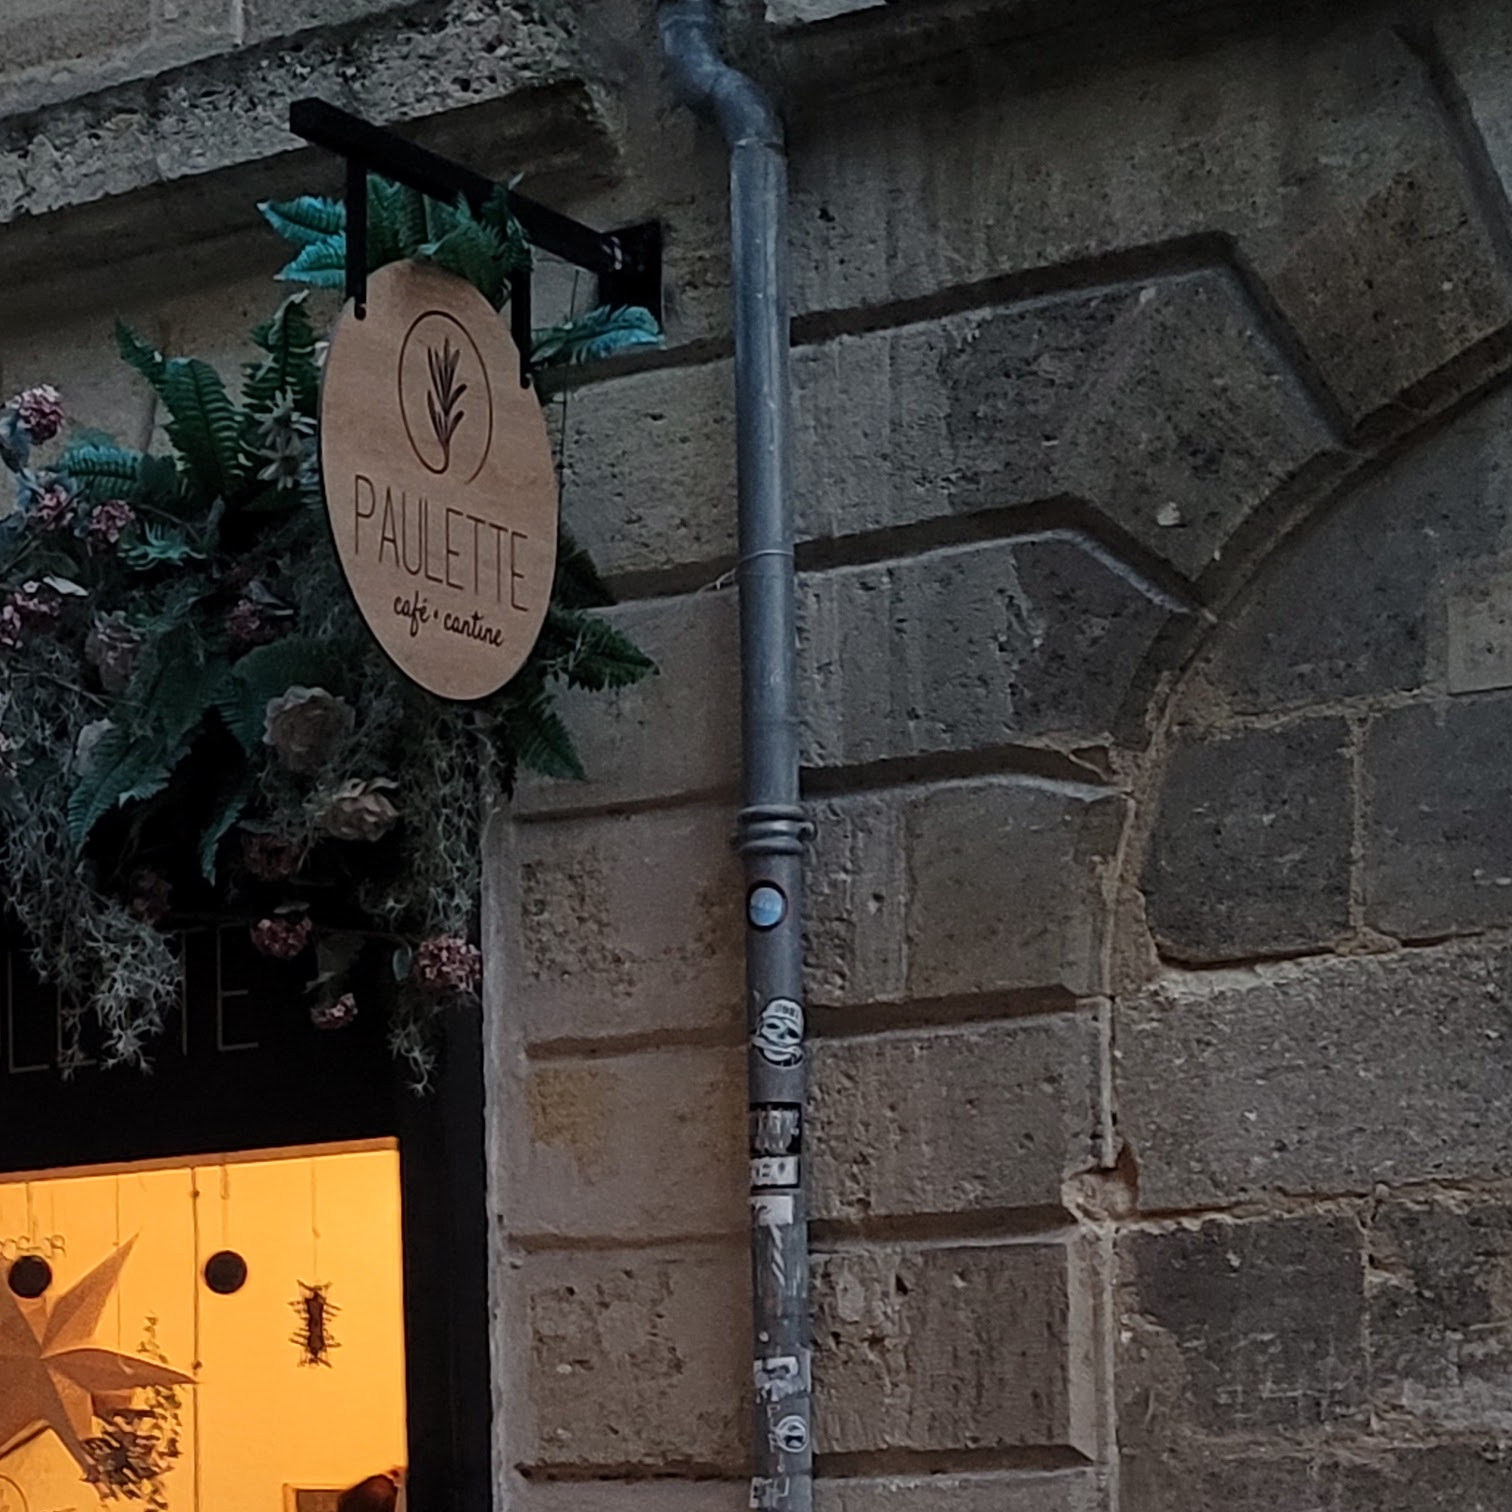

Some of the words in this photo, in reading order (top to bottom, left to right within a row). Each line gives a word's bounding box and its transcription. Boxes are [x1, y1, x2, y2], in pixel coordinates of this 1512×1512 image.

[353, 474, 530, 613] PAULETTE
[393, 590, 431, 638] café
[442, 610, 505, 648] cantine
